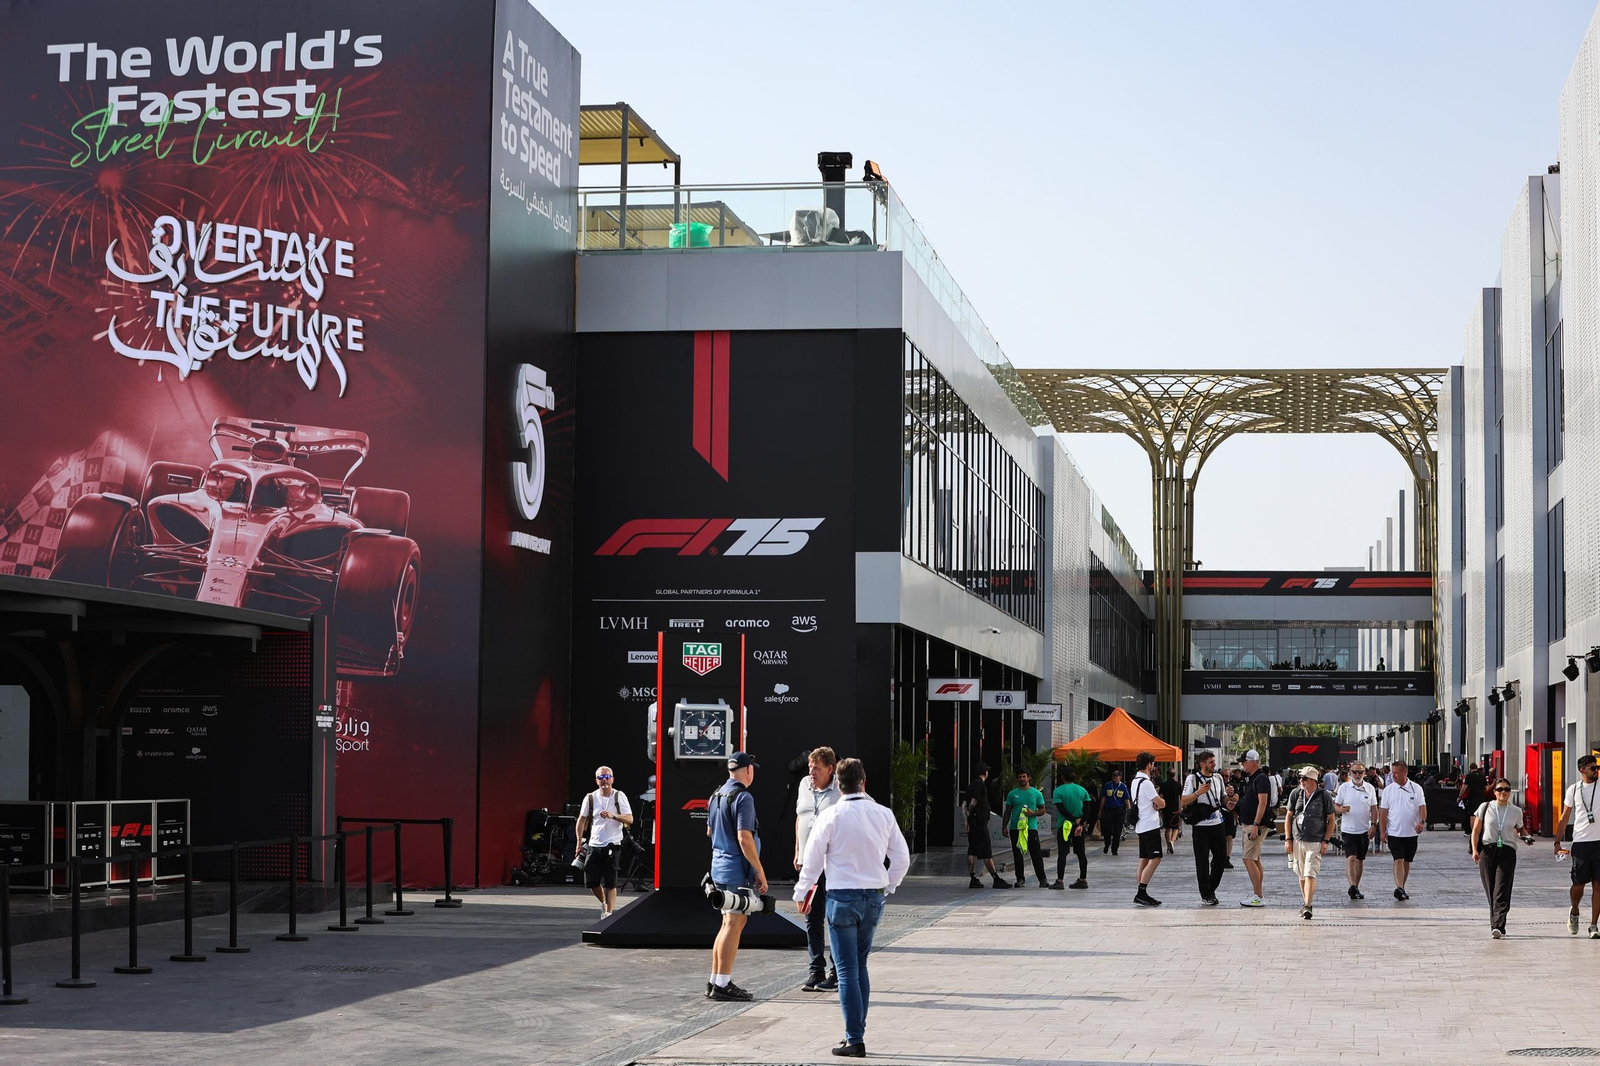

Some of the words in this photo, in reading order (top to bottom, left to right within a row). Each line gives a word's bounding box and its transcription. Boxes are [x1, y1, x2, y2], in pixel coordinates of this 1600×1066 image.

[47, 42, 152, 82] The
[165, 29, 383, 76] World’s
[502, 29, 515, 71] A
[518, 38, 548, 98] True
[107, 79, 316, 125] Fastest
[502, 67, 573, 159] Testament
[70, 99, 188, 168] Street
[192, 87, 342, 166] Circuit!
[501, 112, 517, 156] to
[520, 125, 561, 188] Speed
[151, 215, 355, 278] OVERTAKE
[228, 298, 364, 352] FUTURE
[298, 443, 358, 452] ARABIA
[722, 517, 826, 556] 75
[600, 616, 649, 630] LVMH
[669, 618, 705, 628] PIRELLI
[725, 619, 770, 628] aramco
[791, 615, 817, 625] aws
[686, 644, 718, 655] TAG
[753, 650, 788, 661] QATAR
[685, 657, 719, 674] HEUER
[935, 683, 974, 694] F1
[764, 695, 799, 704] salesforce
[995, 695, 1013, 703] FIA
[335, 738, 370, 754] Sport
[1289, 745, 1320, 754] F1
[120, 822, 141, 838] F1
